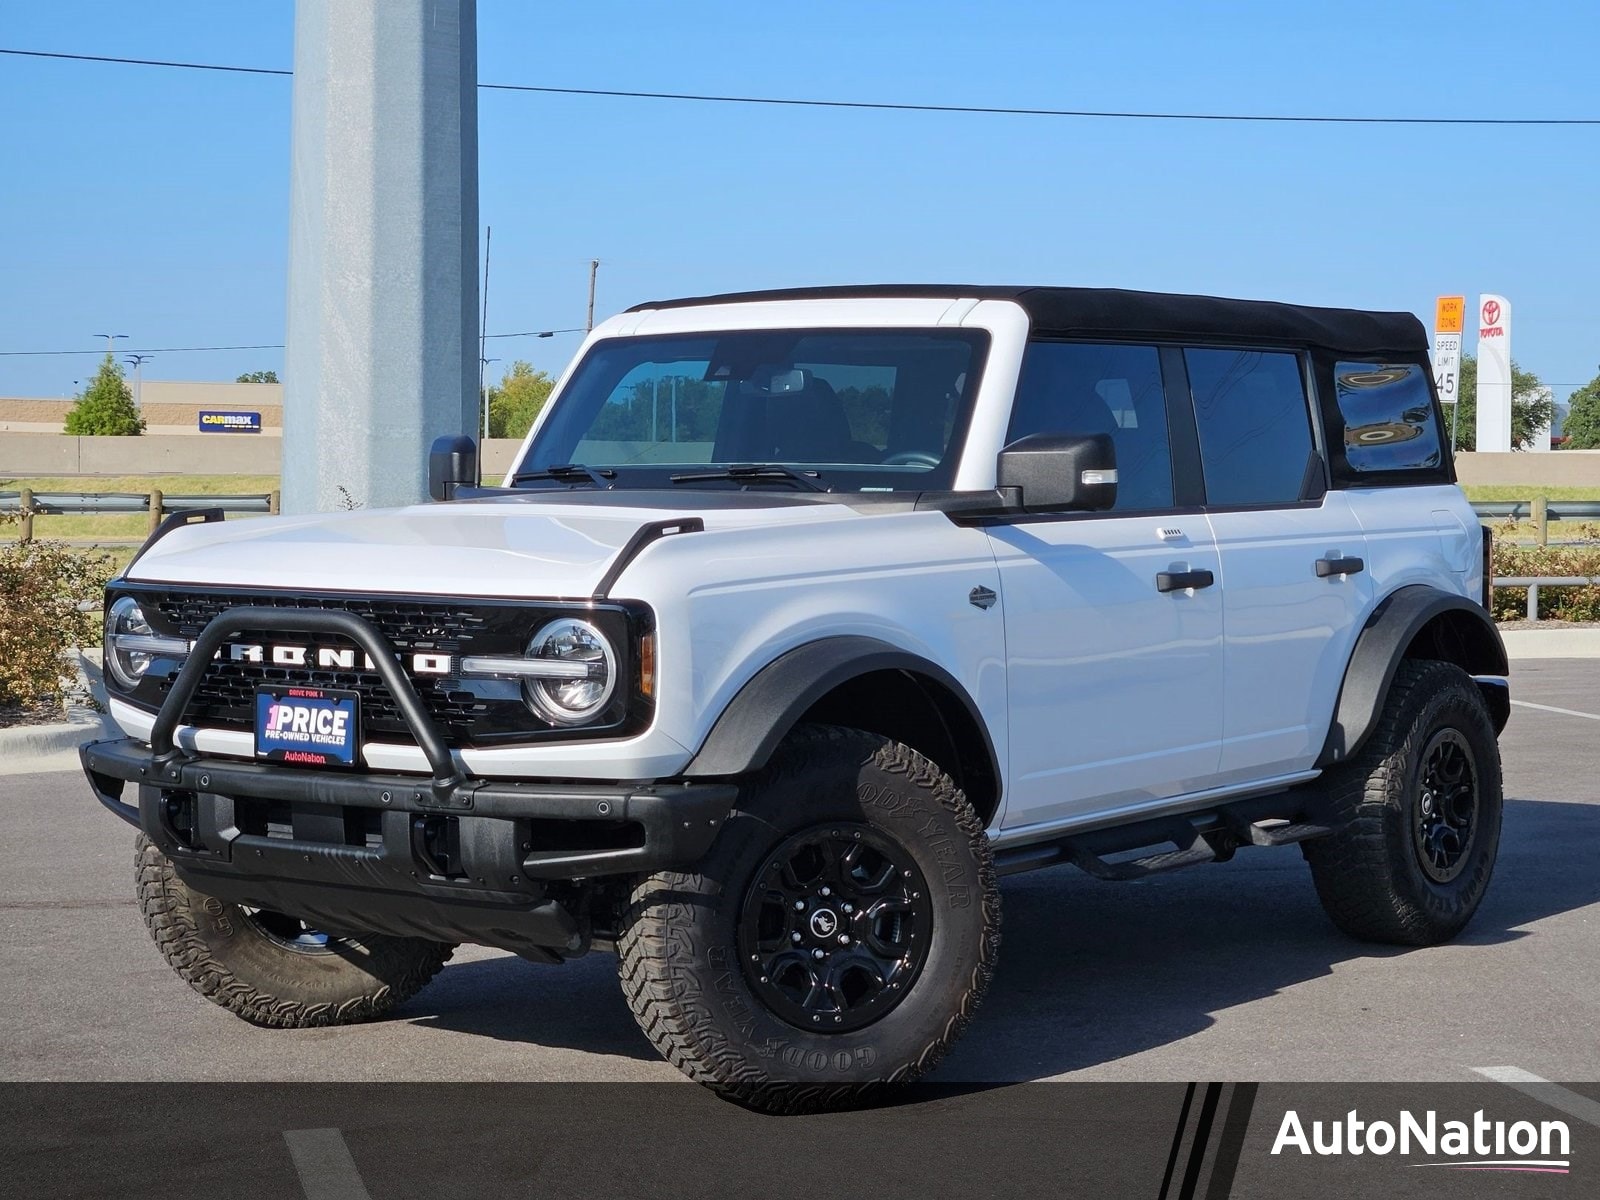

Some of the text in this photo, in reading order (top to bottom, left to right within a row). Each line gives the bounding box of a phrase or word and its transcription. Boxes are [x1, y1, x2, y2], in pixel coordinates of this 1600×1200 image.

[1440, 317, 1456, 328] ZONE
[1480, 327, 1504, 339] TOYOTA
[1437, 340, 1458, 351] SPEED
[1438, 356, 1454, 367] LIMIT
[1436, 373, 1454, 393] 45
[265, 729, 346, 746] PRE-OWNED VEHICLES
